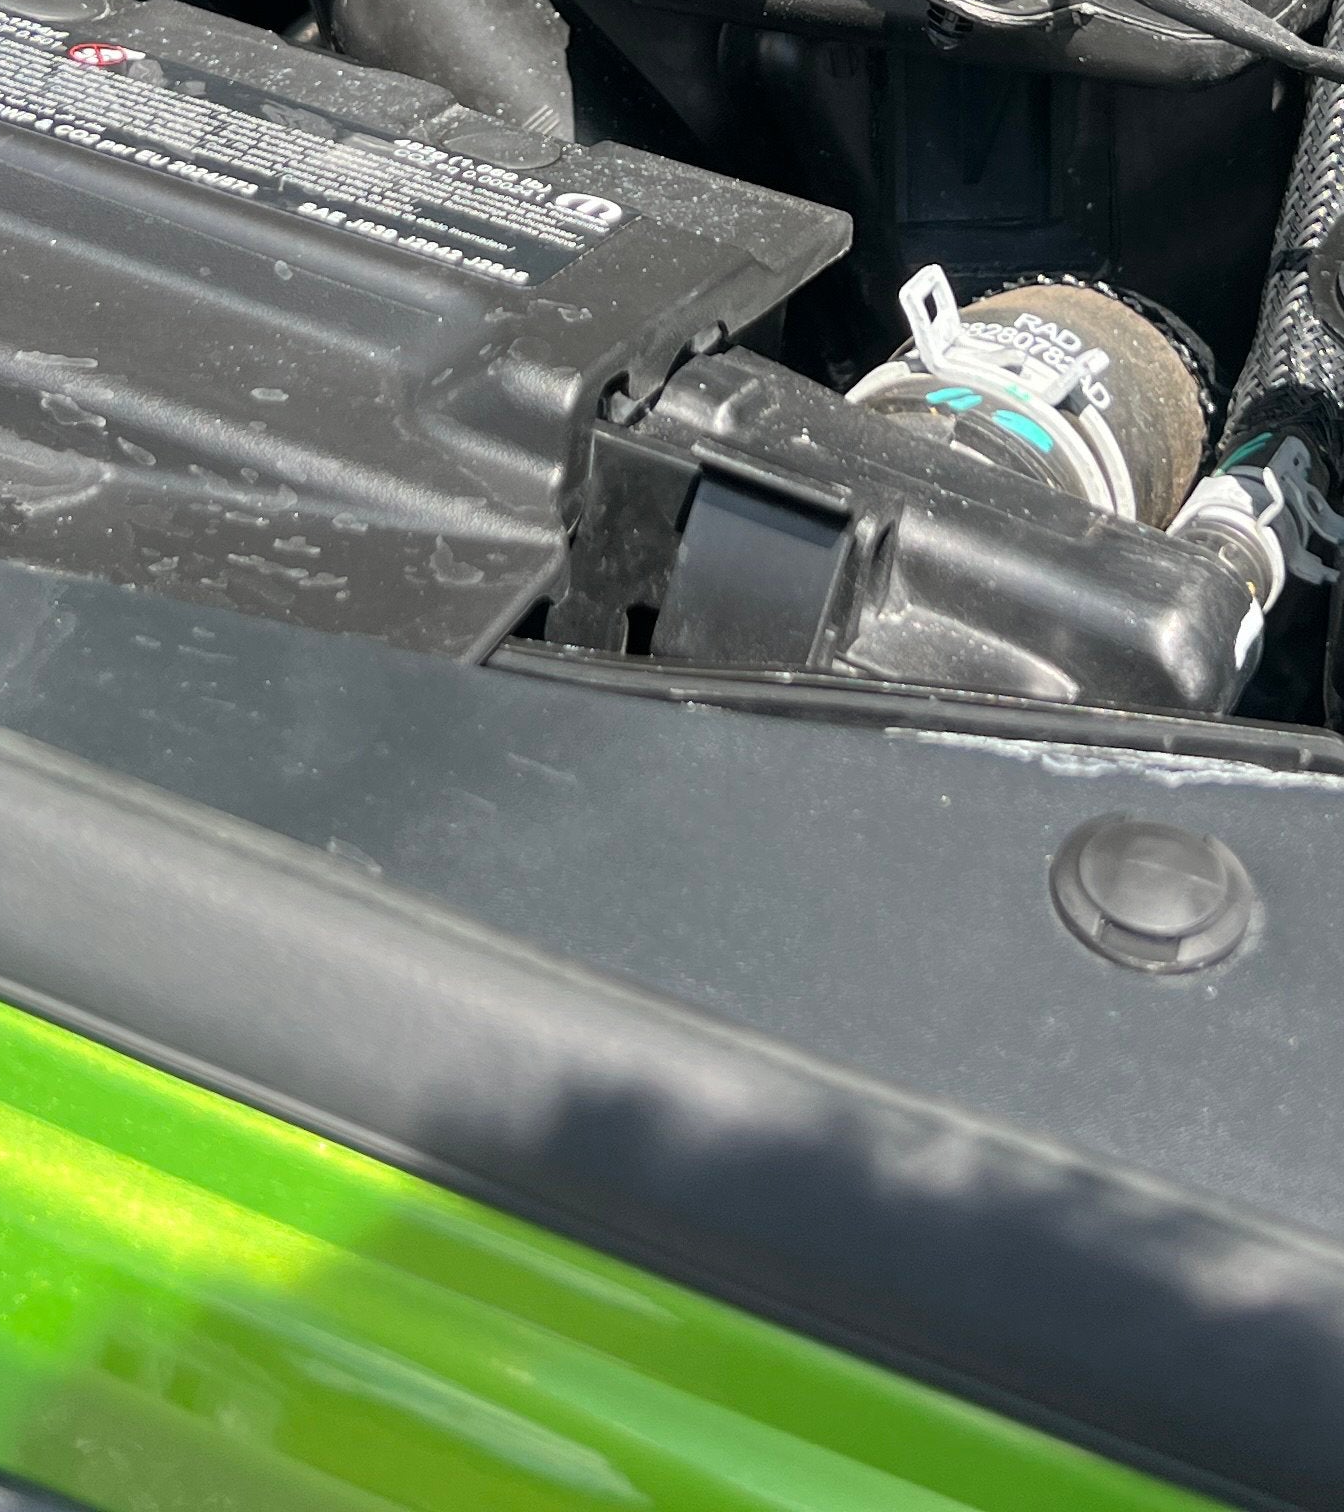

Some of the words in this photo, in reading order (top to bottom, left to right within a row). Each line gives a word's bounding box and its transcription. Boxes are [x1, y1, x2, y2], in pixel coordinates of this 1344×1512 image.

[53, 124, 102, 145] CO2
[95, 139, 137, 157] per
[134, 149, 171, 167] EU
[166, 159, 259, 195] 2024/573
[393, 148, 436, 165] CO2
[297, 201, 347, 223] SAE
[1014, 313, 1081, 352] RAD
